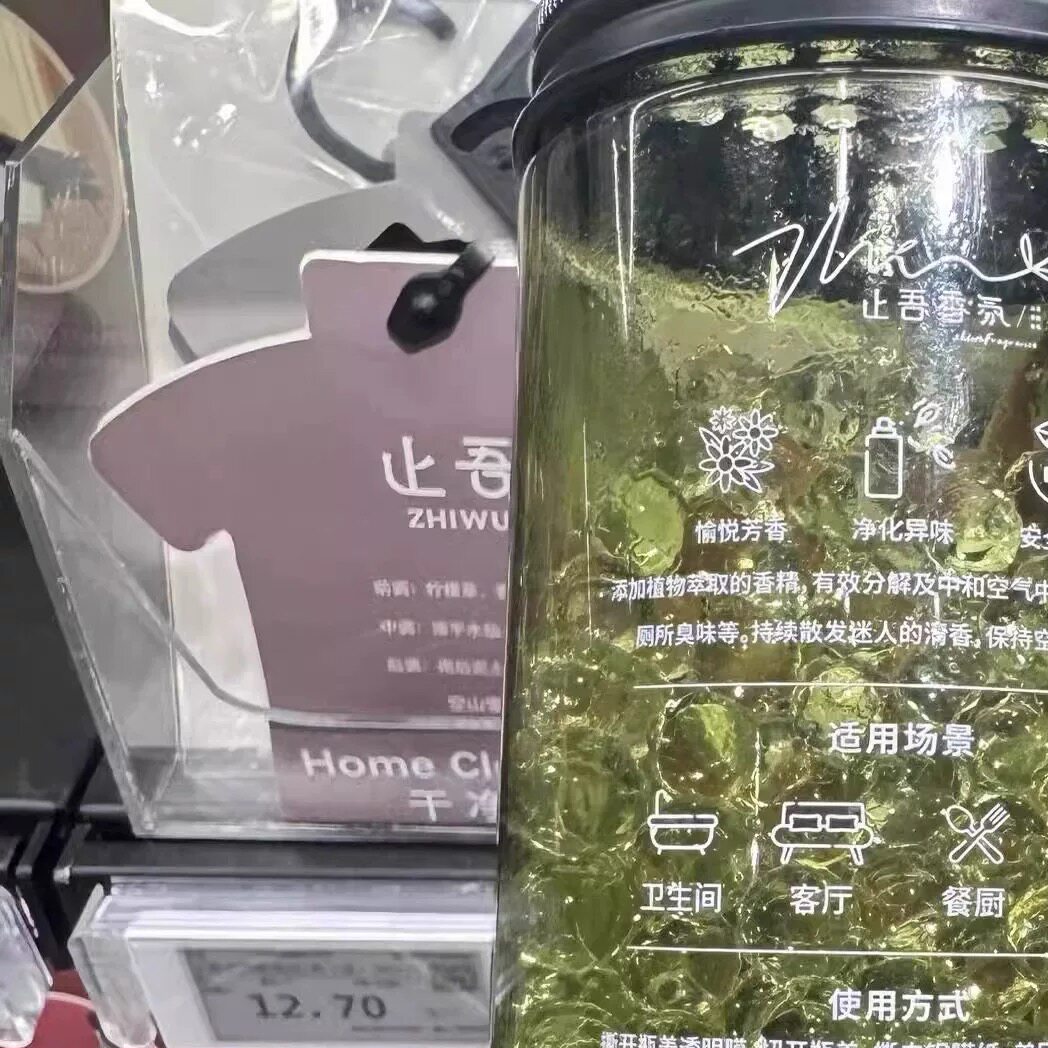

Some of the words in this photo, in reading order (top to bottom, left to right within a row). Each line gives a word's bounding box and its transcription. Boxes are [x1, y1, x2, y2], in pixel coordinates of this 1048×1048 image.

[695, 518, 787, 544] 愉悦芳香
[852, 518, 953, 545] 净化异味
[828, 721, 976, 758] 适用场景
[300, 748, 436, 780] Home
[450, 750, 500, 781] Cl
[640, 883, 724, 914] 卫生间
[789, 884, 854, 916] 客厅
[941, 887, 1006, 919] 餐厨
[249, 993, 387, 1020] 12.70
[829, 988, 971, 1023] 使用方式
